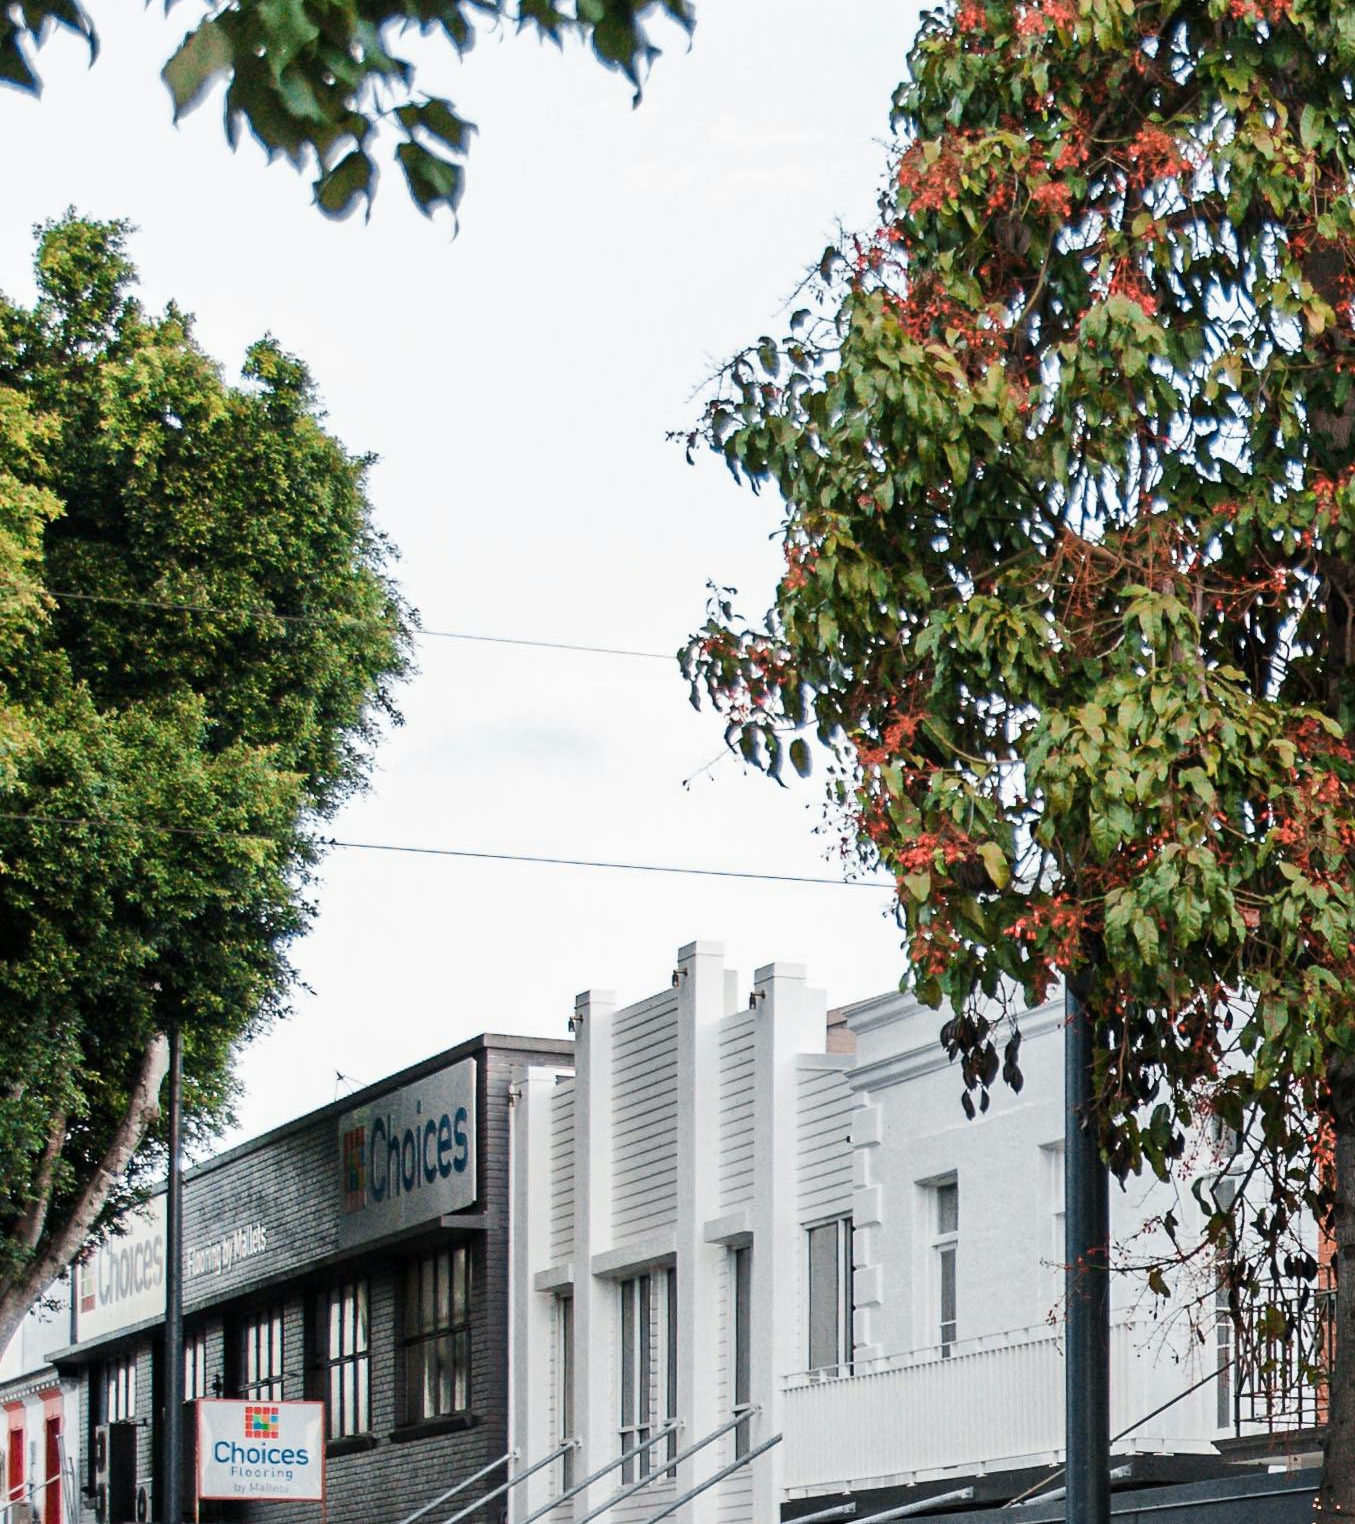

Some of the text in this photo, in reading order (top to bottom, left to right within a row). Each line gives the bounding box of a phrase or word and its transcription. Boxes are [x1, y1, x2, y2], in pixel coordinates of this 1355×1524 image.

[370, 1100, 468, 1202] Choices
[99, 1235, 163, 1306] Choices
[214, 1441, 309, 1465] Choices
[231, 1466, 293, 1481] Flooring
[234, 1483, 246, 1493] by
